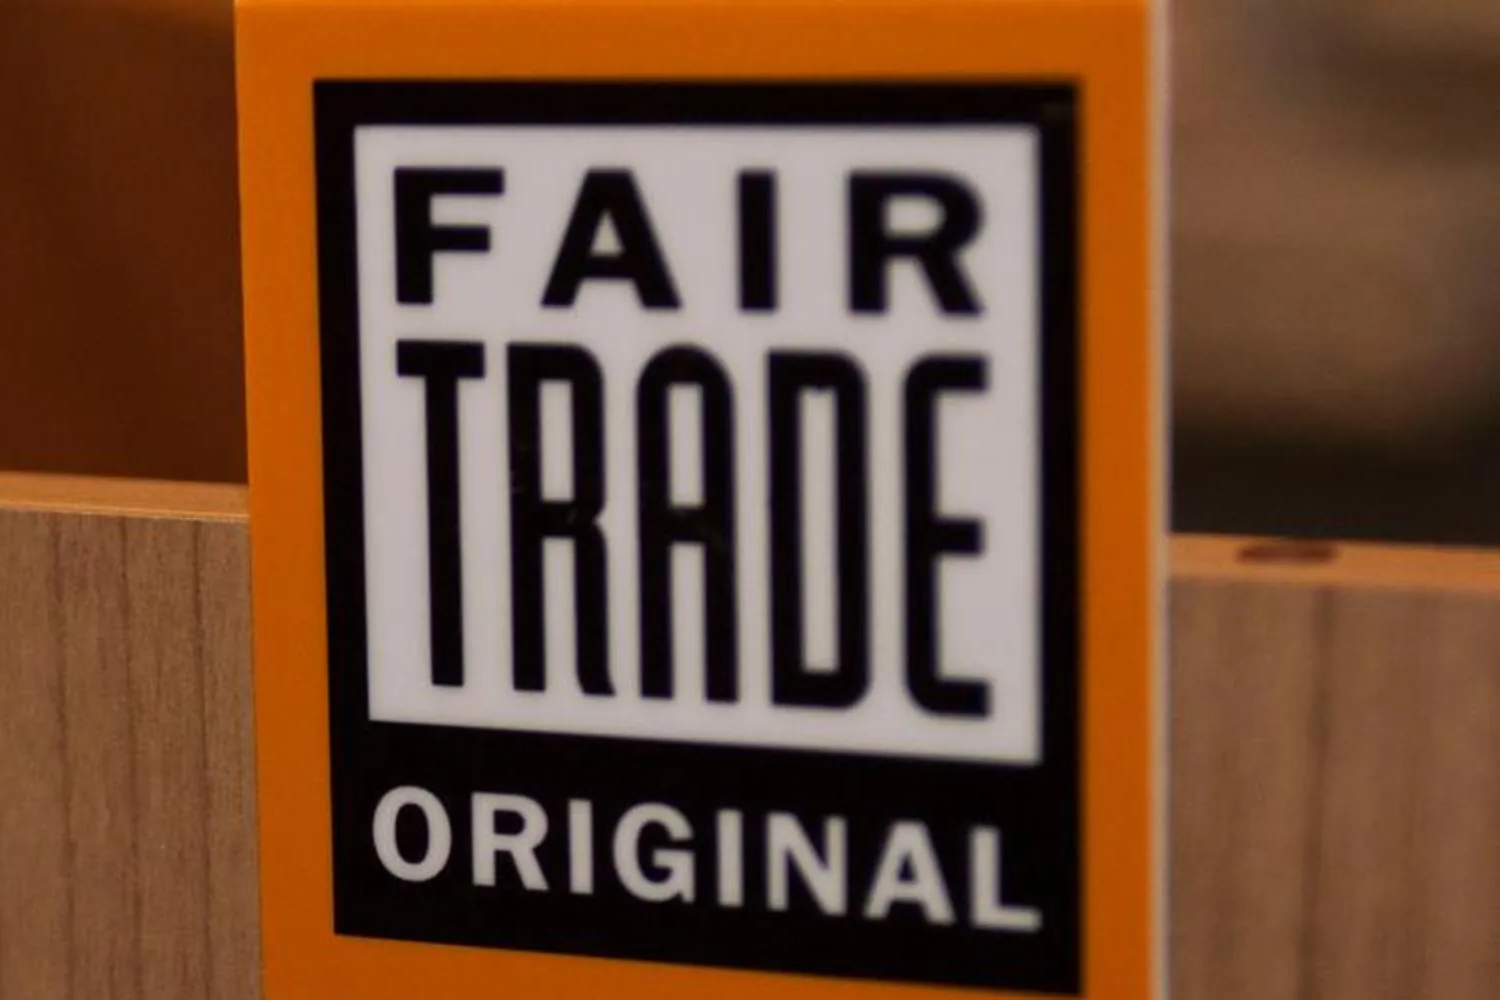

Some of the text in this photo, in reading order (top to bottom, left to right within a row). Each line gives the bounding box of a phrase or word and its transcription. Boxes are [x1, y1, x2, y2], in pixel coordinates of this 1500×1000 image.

[391, 165, 988, 319] FAIR
[394, 338, 992, 719] TRADE
[370, 784, 1043, 933] ORIGINAL
